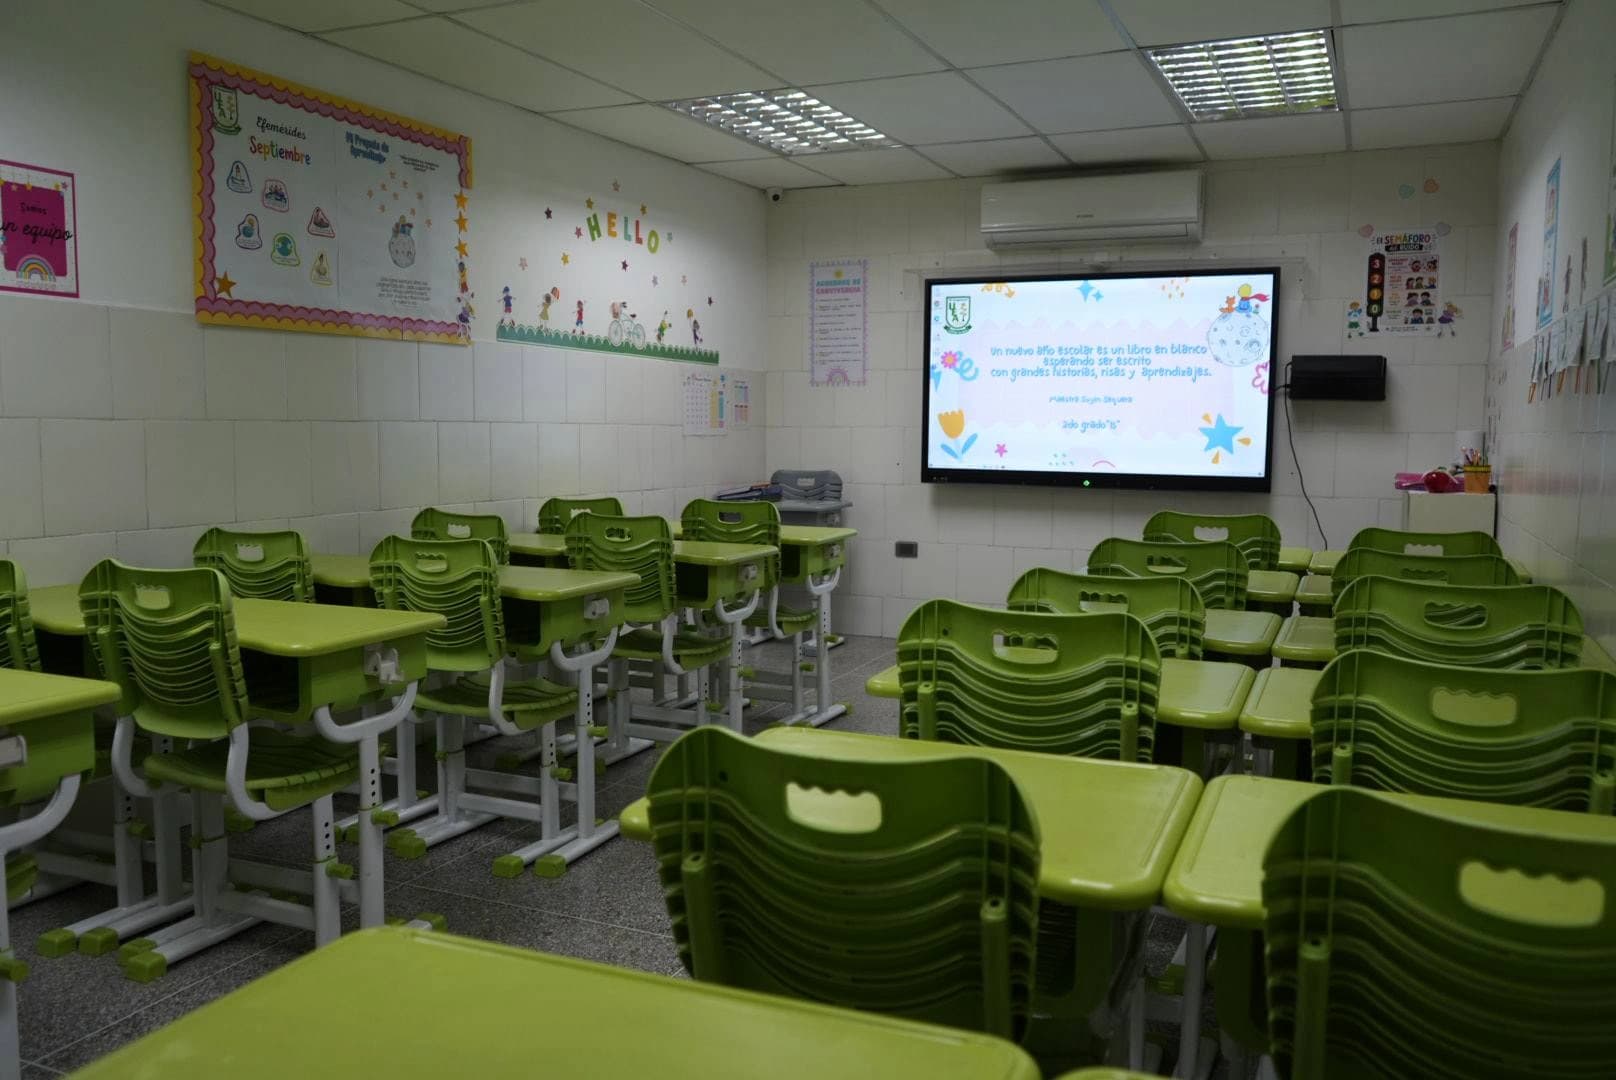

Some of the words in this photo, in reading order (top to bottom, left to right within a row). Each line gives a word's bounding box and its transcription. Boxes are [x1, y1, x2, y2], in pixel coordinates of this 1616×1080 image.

[256, 116, 307, 140] Efemérides
[249, 135, 312, 165] Septiembre
[22, 222, 73, 245] equipo
[586, 211, 660, 254] HELLO
[1384, 233, 1431, 245] SEMÁFORO
[1371, 305, 1378, 314] 0
[1005, 345, 1034, 356] nuevo
[1037, 345, 1056, 356] año
[1058, 344, 1094, 355] escolar
[1096, 344, 1108, 355] es
[1111, 345, 1125, 355] un
[1127, 343, 1152, 355] libro
[1154, 344, 1168, 355] en
[1170, 343, 1208, 355] blanco
[1042, 356, 1095, 368] esperando
[1097, 356, 1113, 366] ser
[1116, 355, 1152, 366] escrito
[991, 367, 1009, 377] con
[1010, 366, 1050, 382] grandes
[1052, 366, 1098, 379] historias,
[1101, 366, 1126, 377] risas
[1128, 368, 1136, 380] y
[1141, 366, 1212, 383] aprendizajes.
